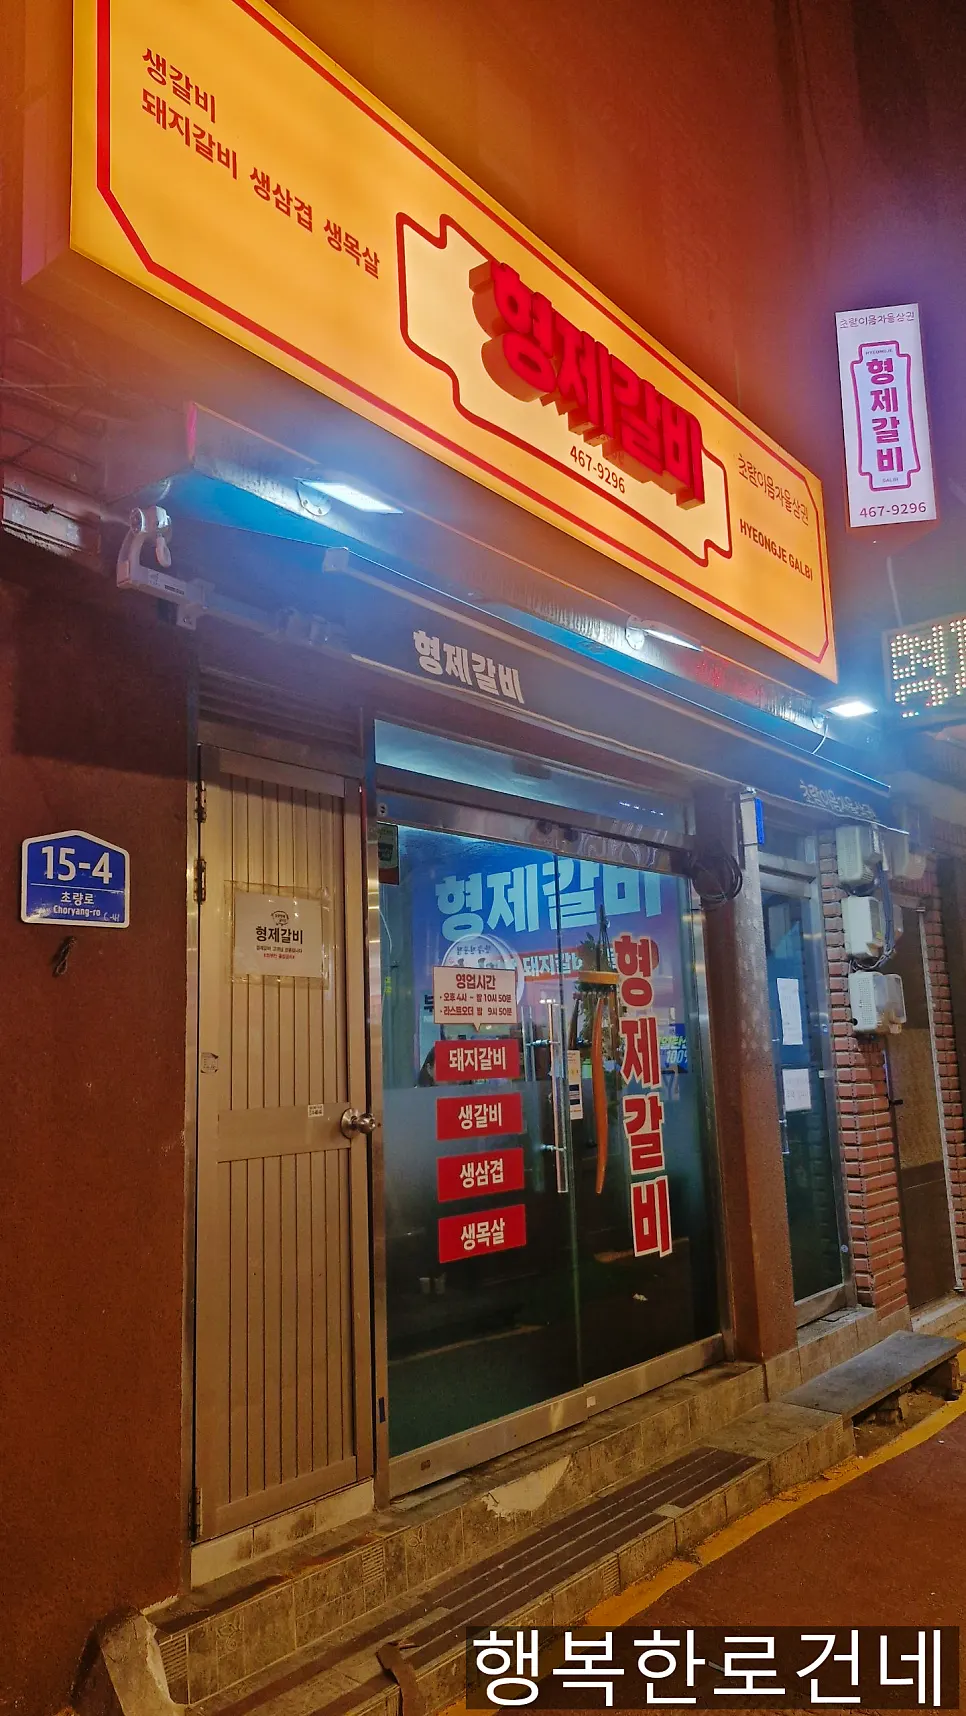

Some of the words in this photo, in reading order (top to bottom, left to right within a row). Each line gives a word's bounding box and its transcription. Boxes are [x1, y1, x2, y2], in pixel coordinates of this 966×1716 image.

[142, 47, 216, 124] 생갈비
[141, 87, 238, 181] 돼지갈비
[249, 166, 314, 234] 생삼겹
[322, 217, 381, 280] 생목살
[484, 260, 707, 509] 형제갈비
[865, 357, 905, 474] 형제갈비
[569, 445, 627, 494] 467-9296
[858, 501, 928, 519] 467-9296
[739, 518, 788, 564] HYEONGJE
[788, 553, 814, 582] GALBI
[412, 629, 526, 705] 형제갈비
[41, 845, 113, 885] 15-4
[53, 905, 101, 917] Choryang-ro
[60, 891, 96, 907] 초량로
[434, 858, 663, 943] 형제갈비
[255, 925, 303, 945] 형제갈비
[455, 973, 497, 991] 영업시간
[443, 1006, 474, 1017] 라스트오더
[487, 1007, 498, 1017] 9시
[498, 1007, 513, 1017] 50분
[449, 1046, 507, 1073] 돼지갈비
[612, 931, 673, 1258] 형제갈비
[458, 1102, 503, 1130] 생갈비
[459, 1157, 505, 1190] 생삼겹
[460, 1216, 506, 1251] 생목살
